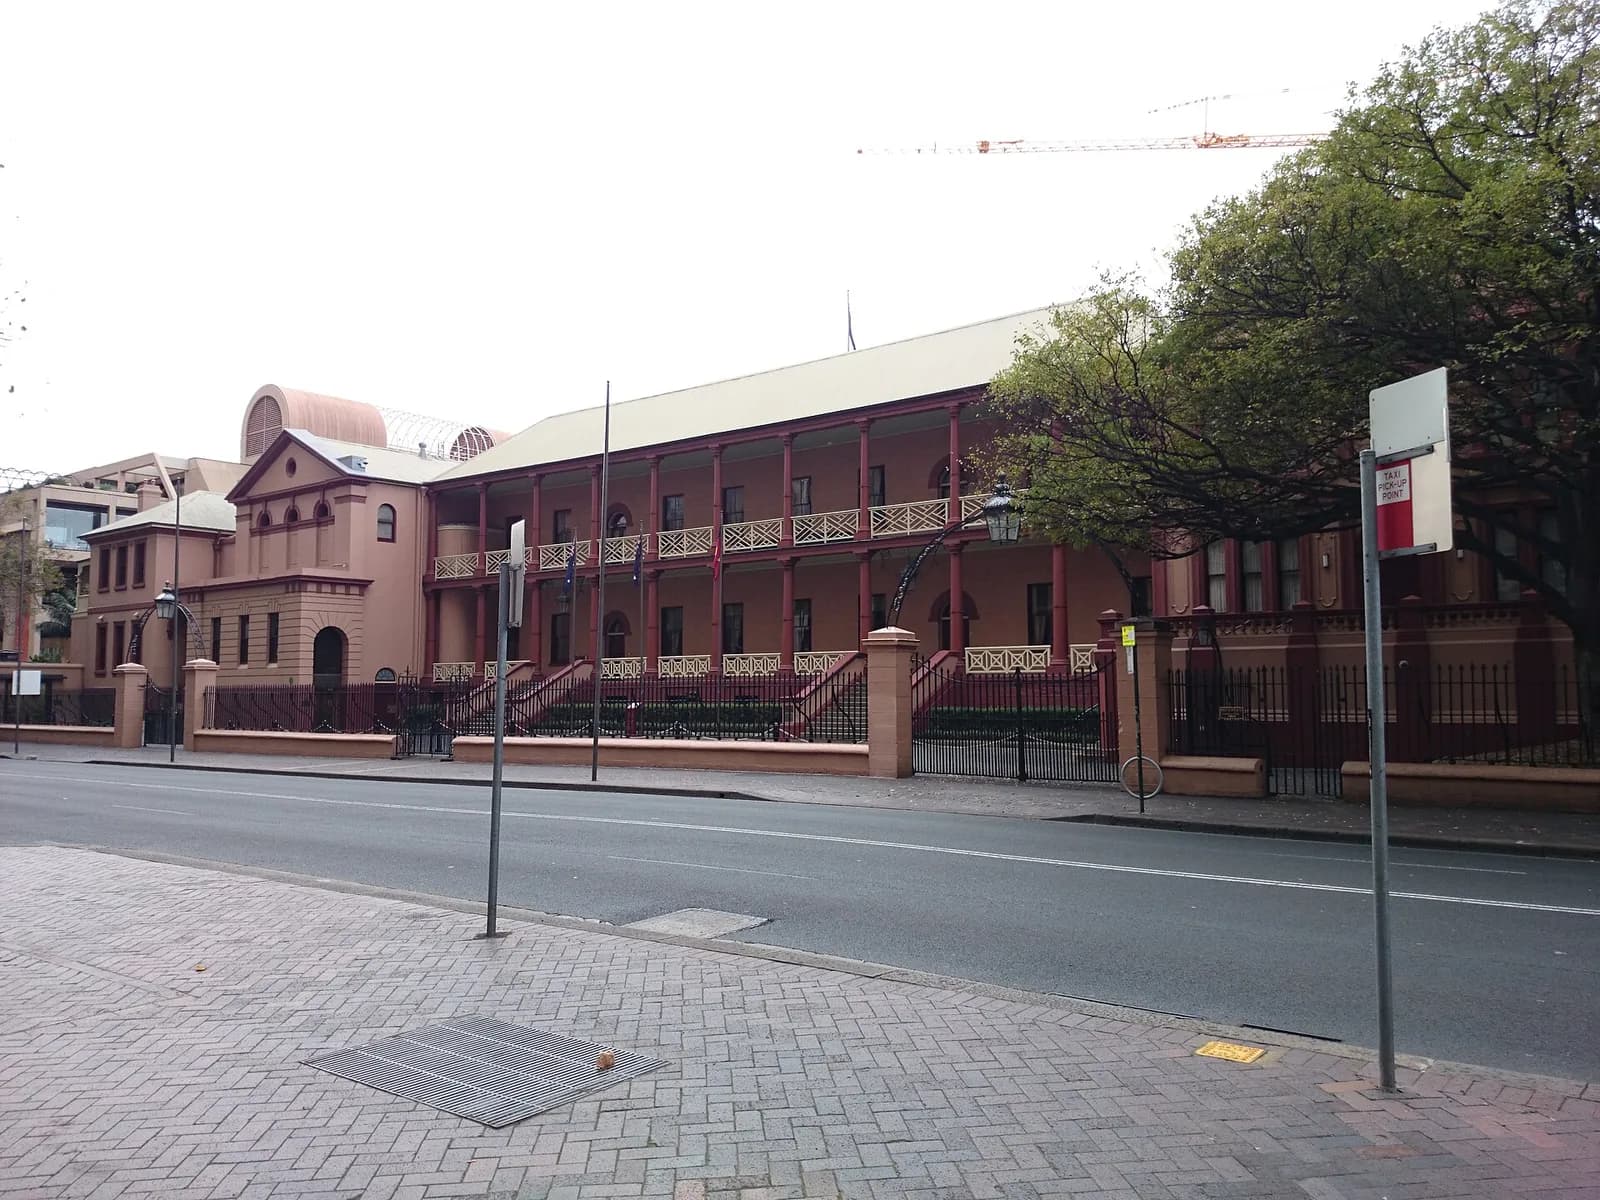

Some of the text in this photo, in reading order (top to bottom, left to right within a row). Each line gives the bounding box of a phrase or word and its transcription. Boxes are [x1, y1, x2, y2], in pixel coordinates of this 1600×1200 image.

[1384, 470, 1401, 480] TAXI
[1378, 479, 1407, 491] PICK-UP
[1382, 490, 1403, 500] POINT
